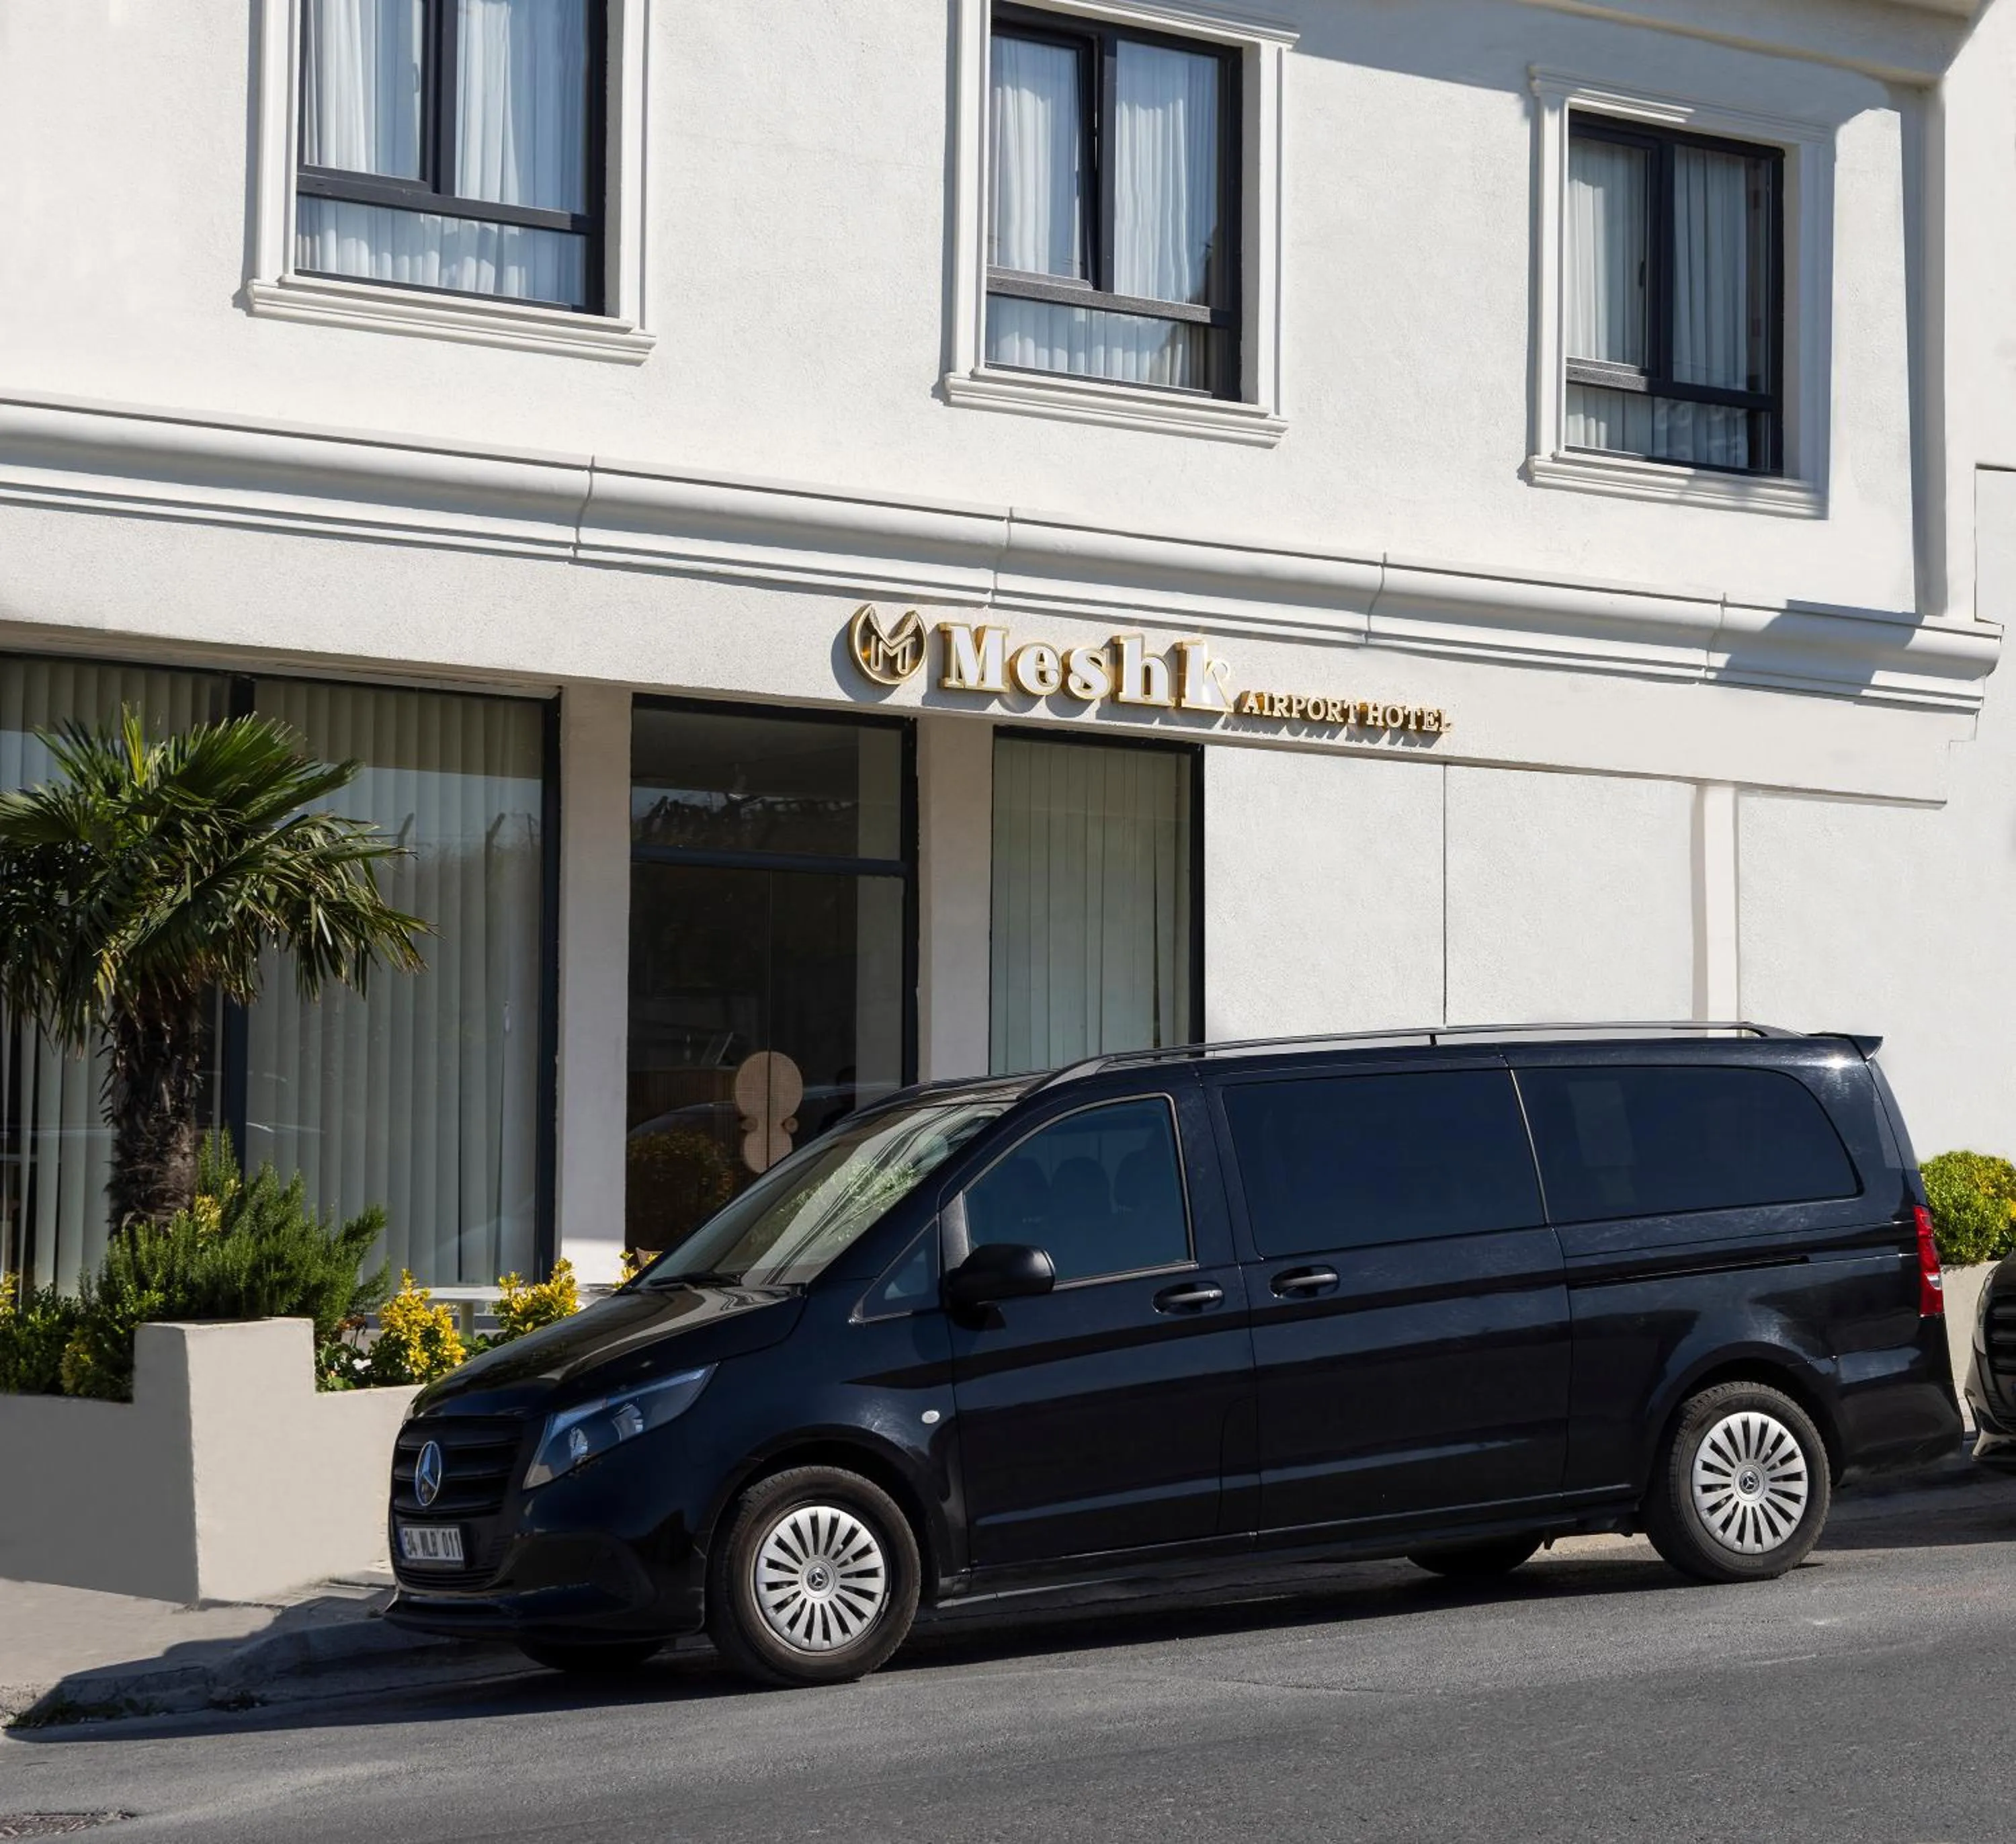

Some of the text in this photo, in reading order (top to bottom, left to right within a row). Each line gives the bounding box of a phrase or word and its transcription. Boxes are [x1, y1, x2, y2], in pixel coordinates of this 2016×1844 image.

[938, 622, 1234, 714] Meshk
[1241, 690, 1453, 732] AIRPORT HOTEL
